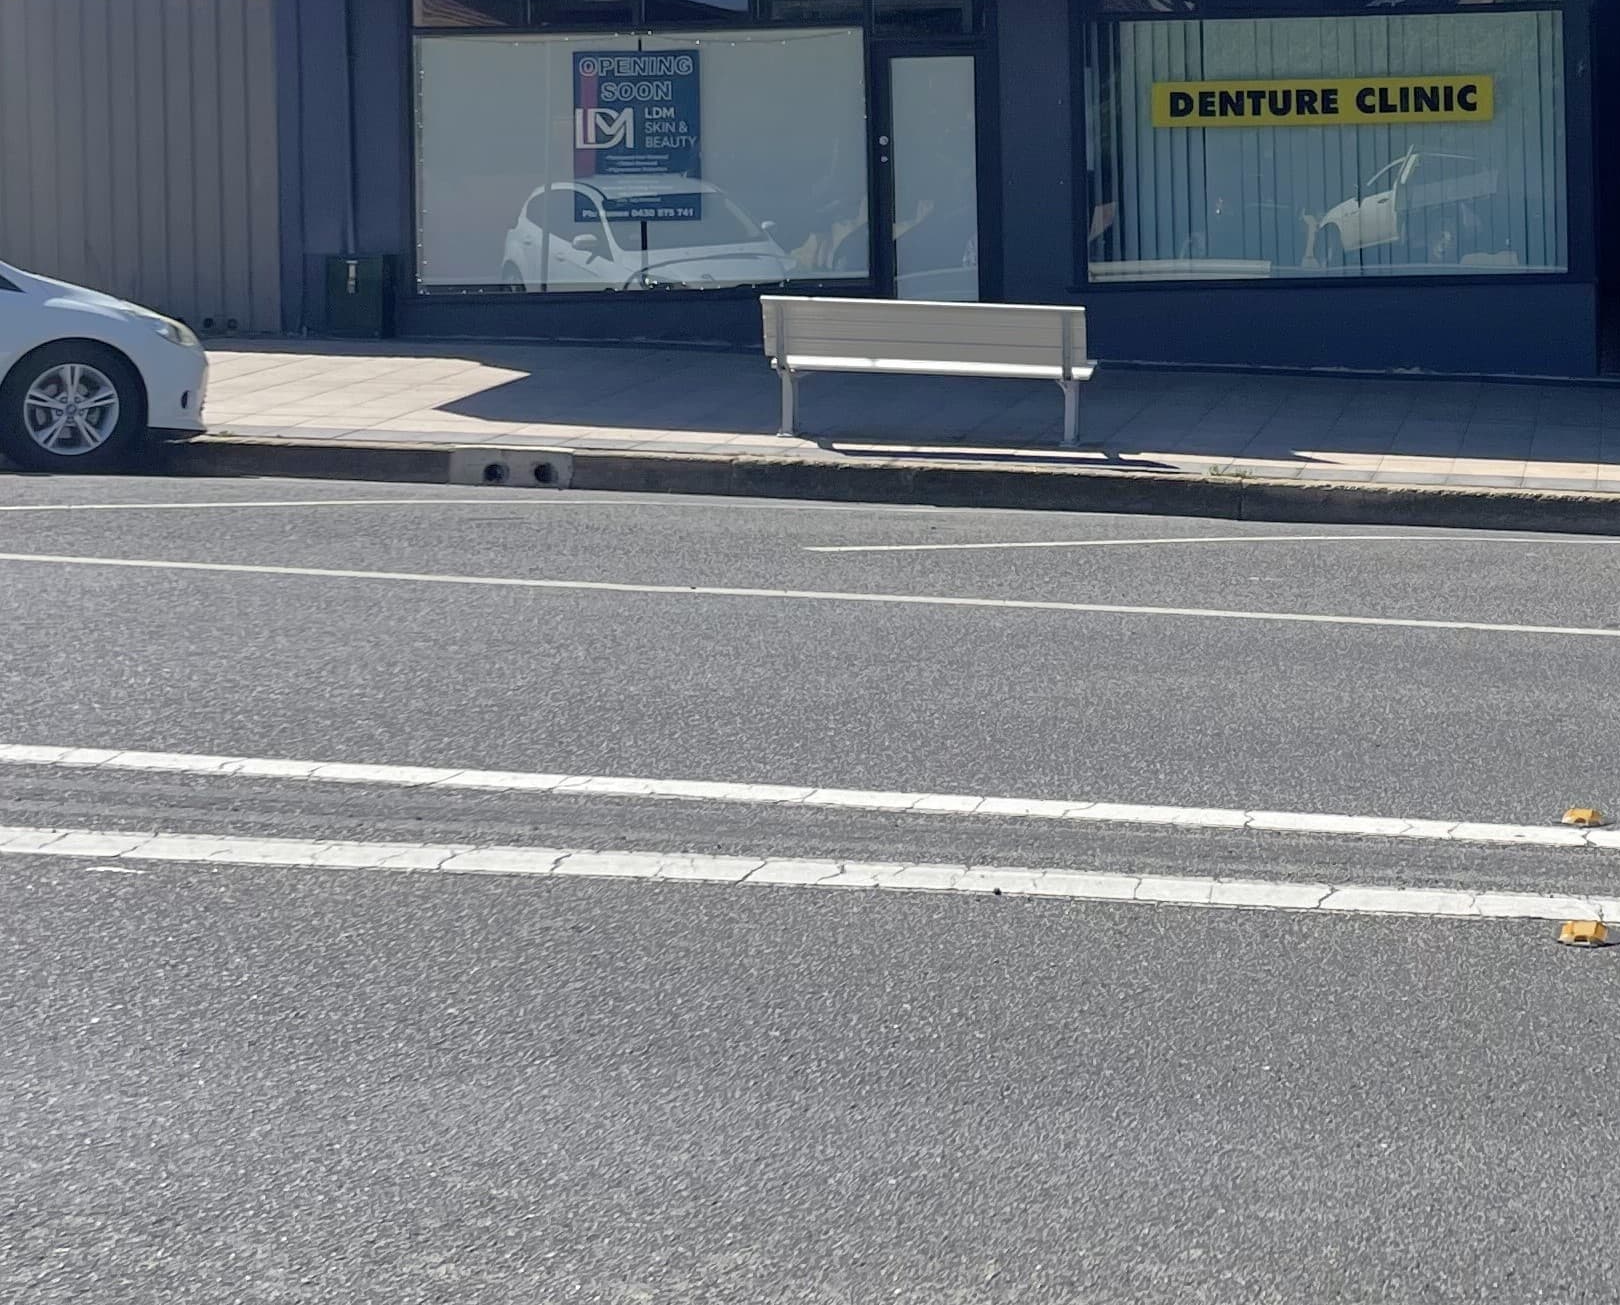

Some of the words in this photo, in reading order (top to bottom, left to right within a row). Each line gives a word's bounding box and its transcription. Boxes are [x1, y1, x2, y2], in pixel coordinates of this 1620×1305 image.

[579, 56, 693, 76] OPENING
[601, 81, 672, 101] SOON
[1169, 89, 1339, 117] DENTURE
[1355, 84, 1478, 114] CLINIC
[645, 107, 675, 119] LDM
[644, 122, 676, 134] SKIN
[678, 121, 688, 133] &
[645, 136, 697, 148] BEAUTY
